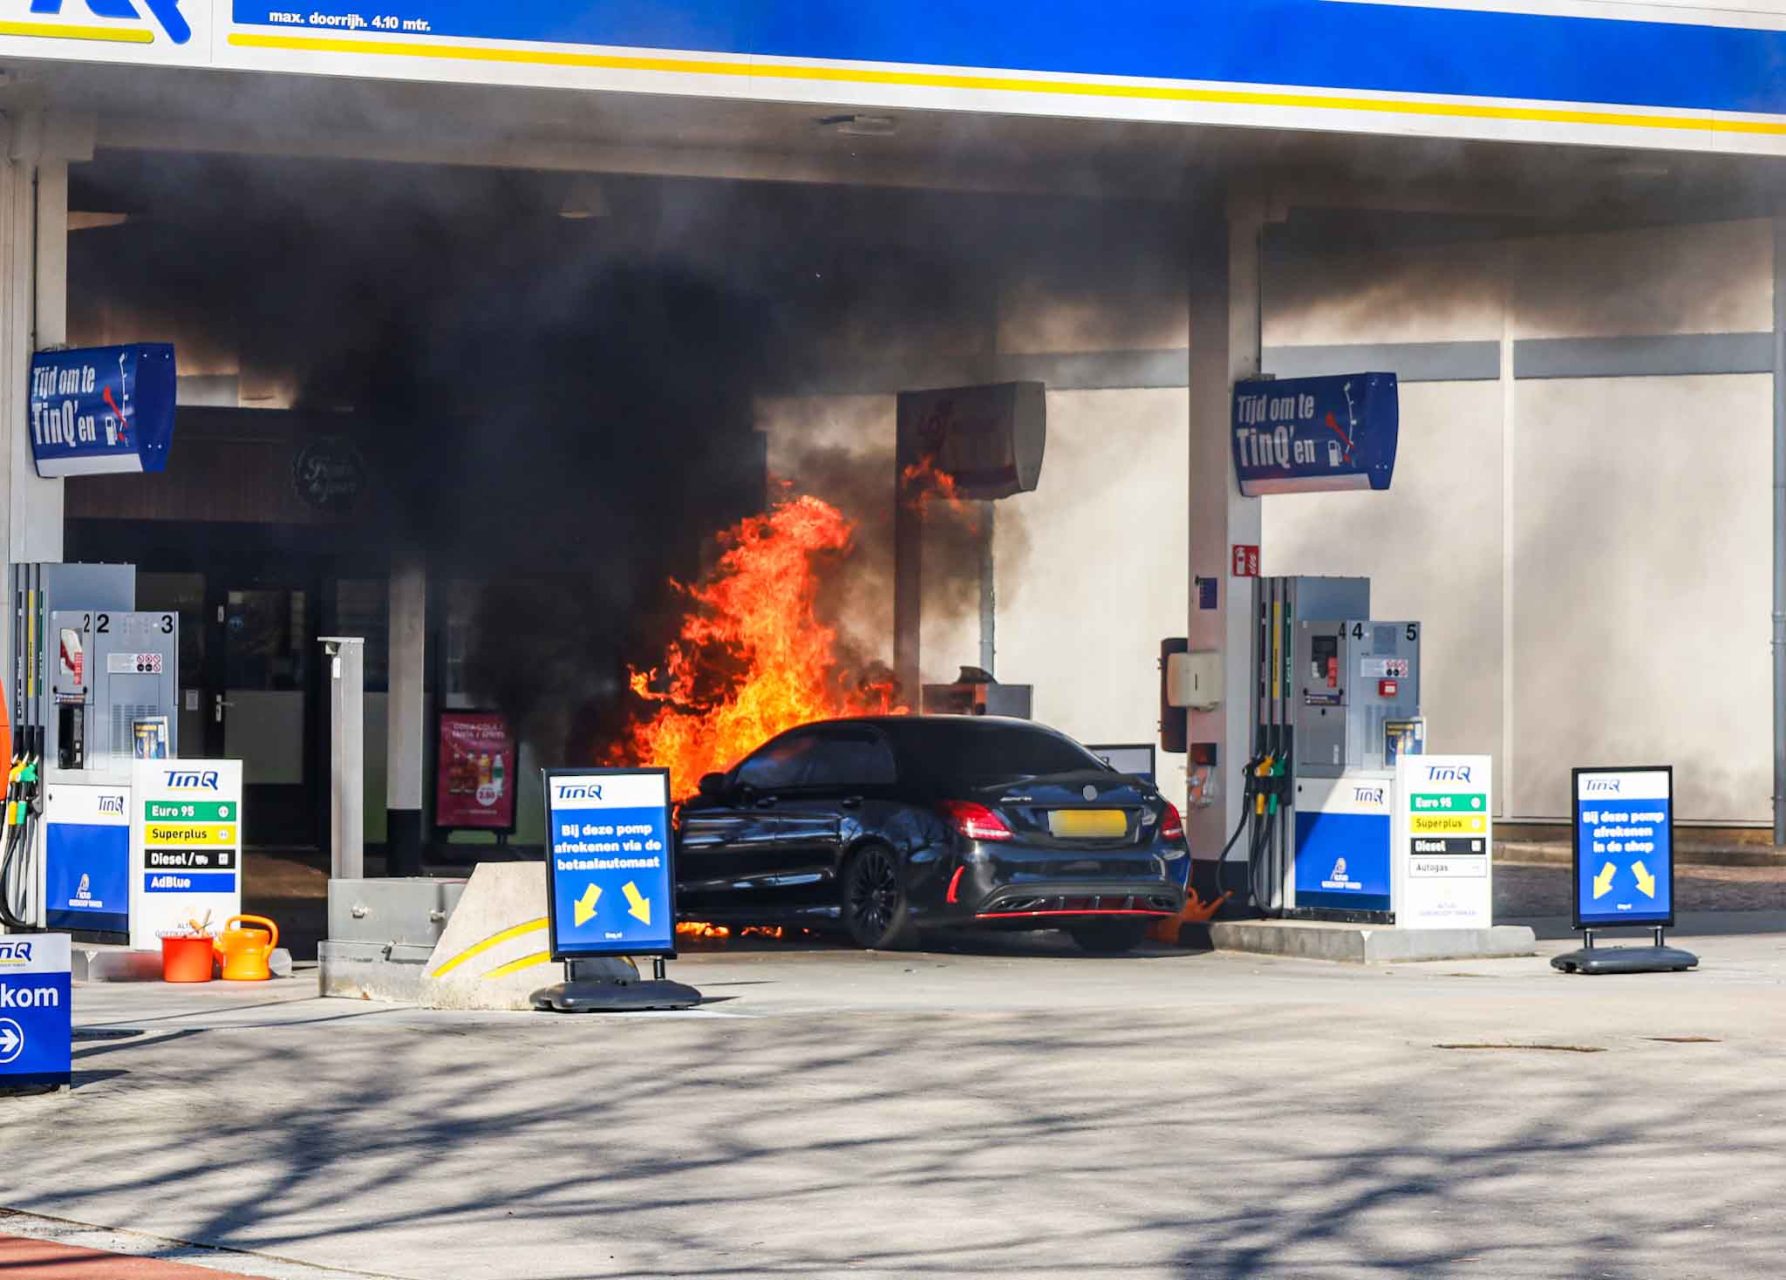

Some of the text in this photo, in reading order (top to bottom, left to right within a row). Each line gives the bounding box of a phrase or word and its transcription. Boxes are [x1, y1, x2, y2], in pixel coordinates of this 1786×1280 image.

[269, 11, 431, 31] max. doorrijh. 4.10 mtr.
[33, 365, 95, 399] Tijd om te
[1238, 393, 1315, 425] Tijd om te
[83, 613, 91, 633] 2
[96, 614, 110, 633] 2
[161, 615, 174, 634] 3
[1338, 622, 1347, 640] 4
[1352, 623, 1364, 640] 4
[1406, 624, 1417, 641] 5
[164, 771, 218, 790] TinQ
[1425, 766, 1471, 783] TinQ
[556, 785, 602, 800] TinQ
[98, 796, 124, 815] TinQ
[1415, 796, 1452, 808] Euro 95
[151, 805, 195, 817] Euro 95
[1582, 811, 1665, 825] Bij deze pomp
[561, 823, 652, 838] Bij deze pomp
[1416, 818, 1463, 829] Superplus
[152, 828, 207, 840] Superplus
[1593, 825, 1653, 838] afrekenen
[555, 839, 662, 854] afrekenen via de
[1414, 840, 1446, 852] Diesel
[151, 852, 186, 864] Diesel
[557, 857, 660, 871] betaalautomaat
[1416, 864, 1448, 874] Autogas
[151, 876, 191, 888] AdBlue
